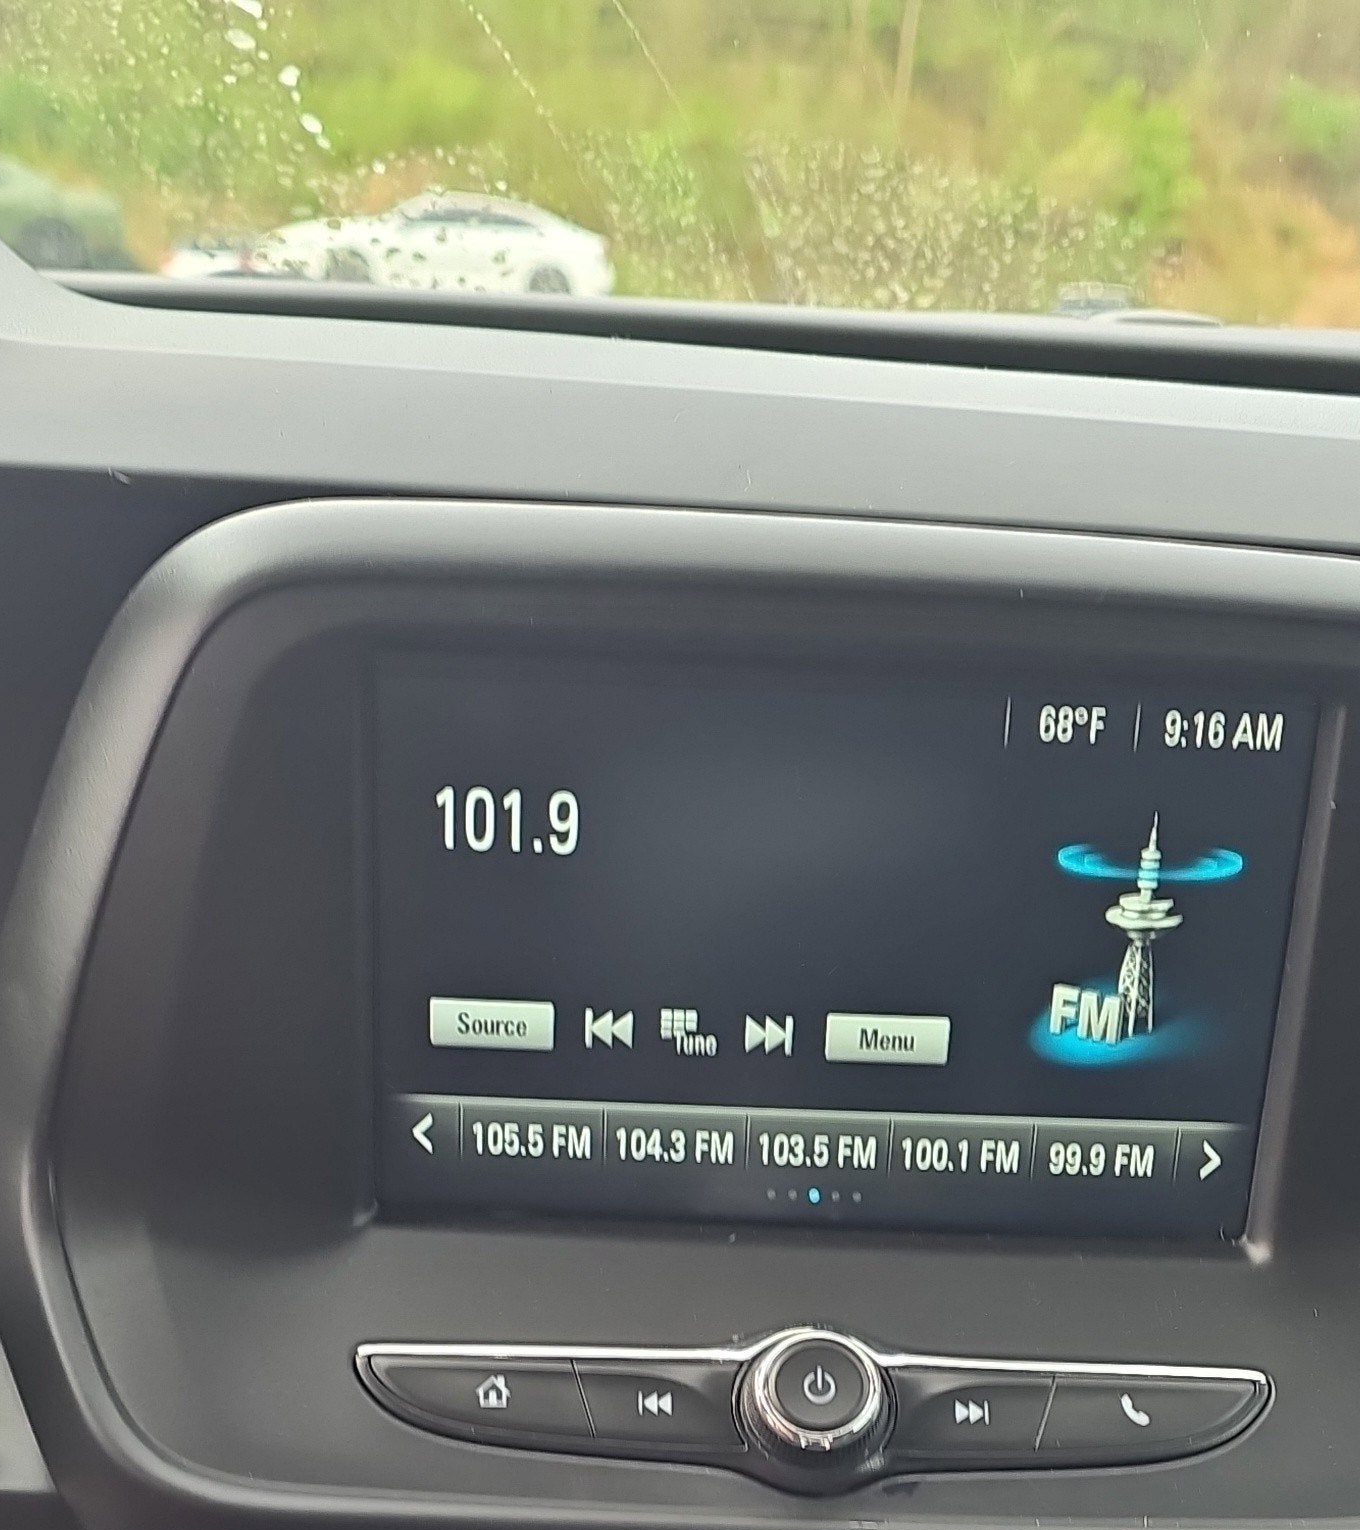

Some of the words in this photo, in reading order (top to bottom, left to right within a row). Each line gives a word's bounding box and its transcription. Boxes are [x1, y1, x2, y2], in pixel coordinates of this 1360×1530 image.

[1163, 708, 1226, 750] 9:16
[1231, 712, 1285, 752] AM
[435, 785, 580, 856] 101.9
[456, 1011, 528, 1039] Source
[1049, 982, 1124, 1046] FM
[674, 1029, 718, 1057] Tune
[857, 1026, 915, 1054] Menu
[472, 1121, 544, 1158] 105.5
[551, 1124, 592, 1161] FM
[615, 1126, 687, 1164] 104.3
[694, 1129, 735, 1166] FM
[758, 1131, 830, 1169] 103.5
[837, 1134, 877, 1170] FM
[901, 1136, 970, 1173] 100.1
[979, 1139, 1020, 1174] FM
[1048, 1141, 1107, 1177] 99.9
[1113, 1143, 1155, 1178] FM
